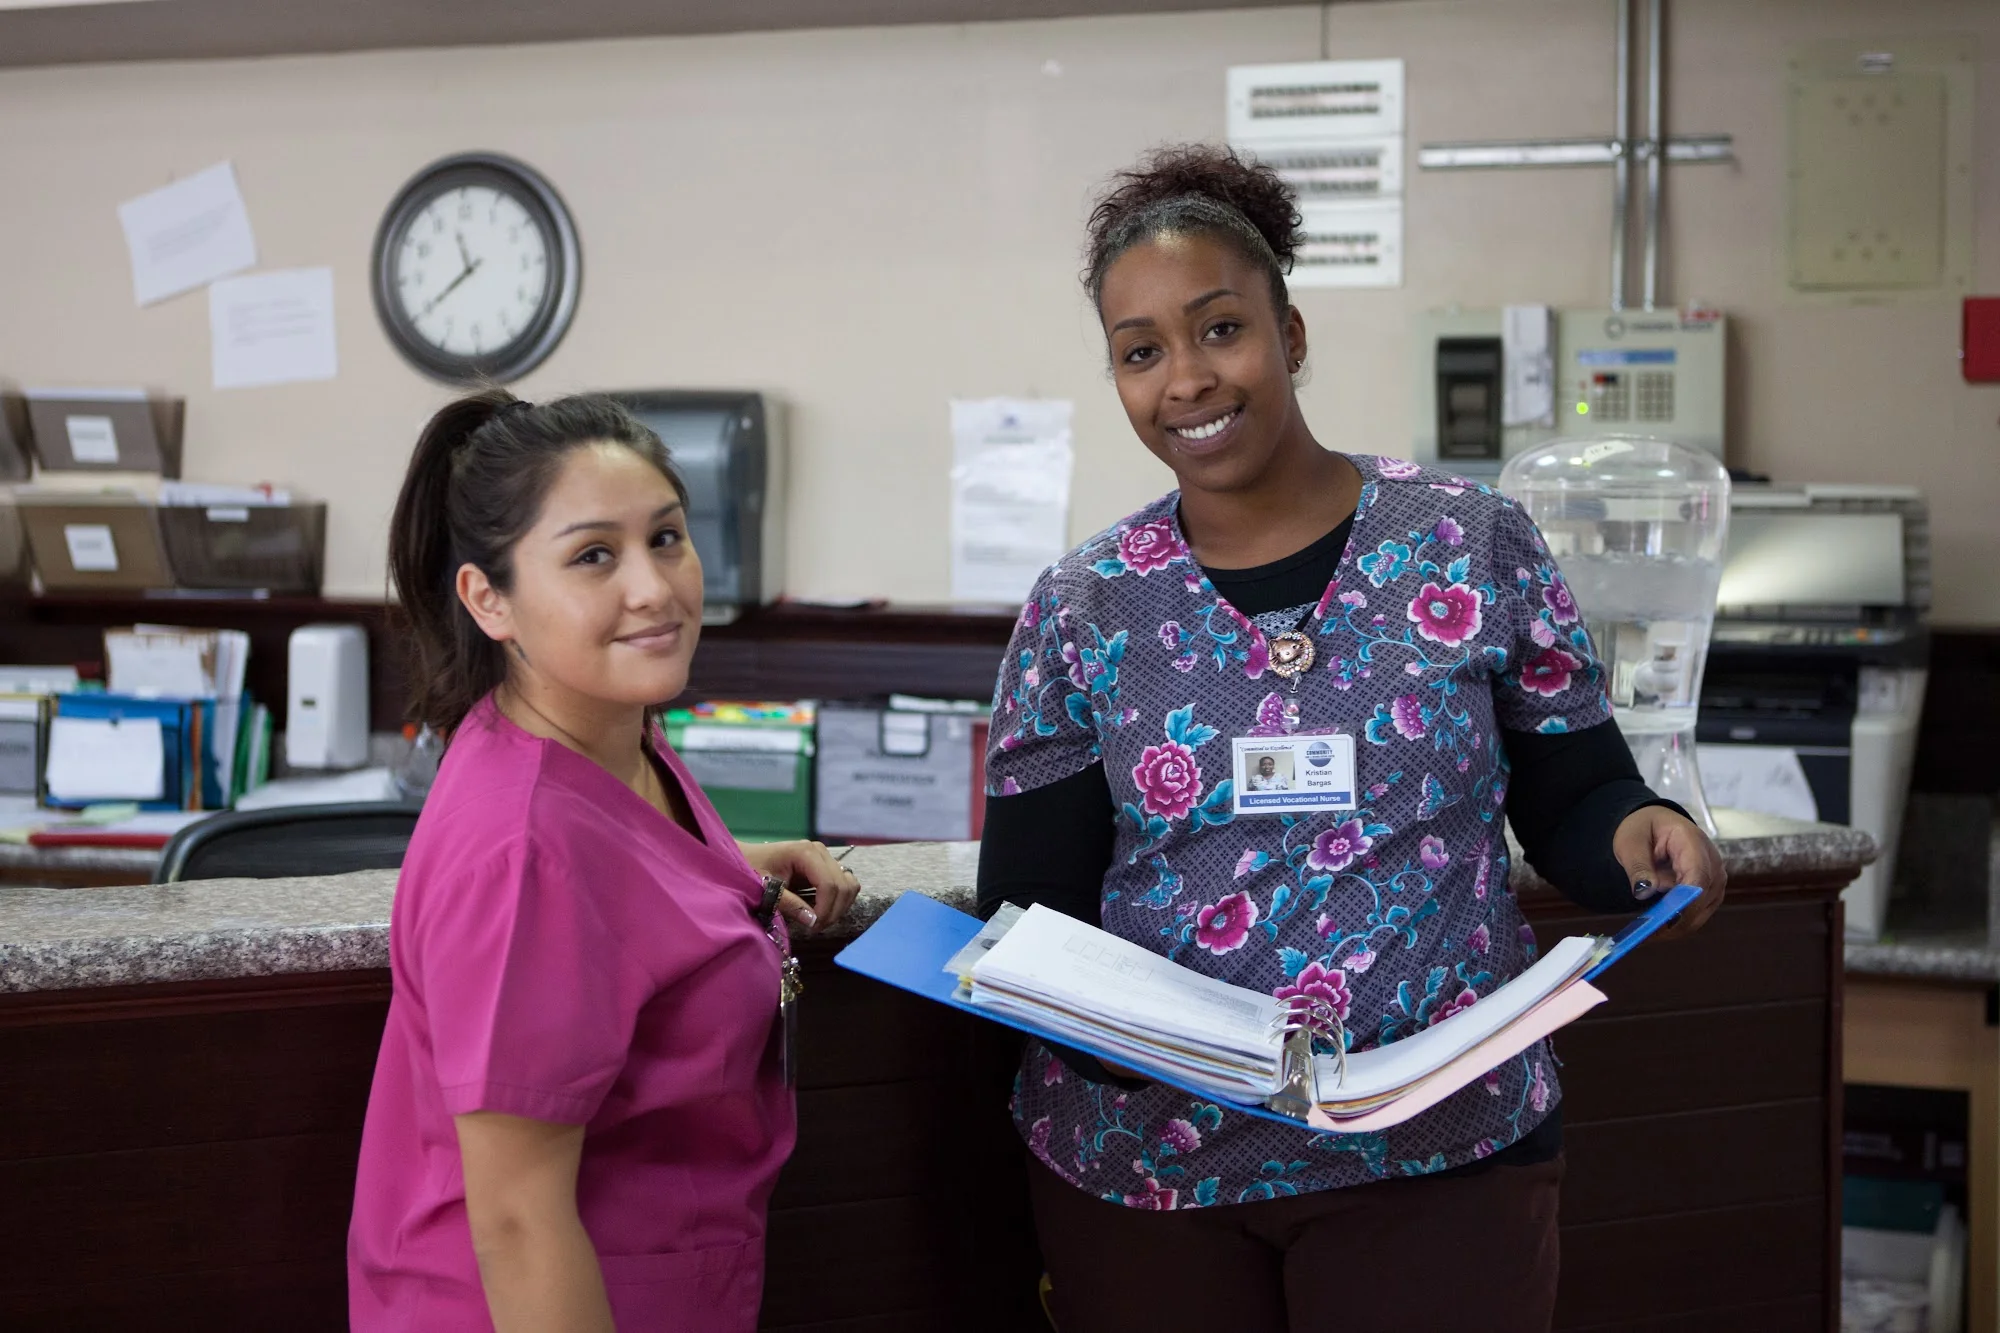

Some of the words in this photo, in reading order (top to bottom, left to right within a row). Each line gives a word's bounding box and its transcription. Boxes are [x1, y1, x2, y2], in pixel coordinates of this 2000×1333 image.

[1249, 797, 1280, 805] Licensed
[1282, 795, 1318, 803] Vocational
[1320, 794, 1340, 802] Nurse
